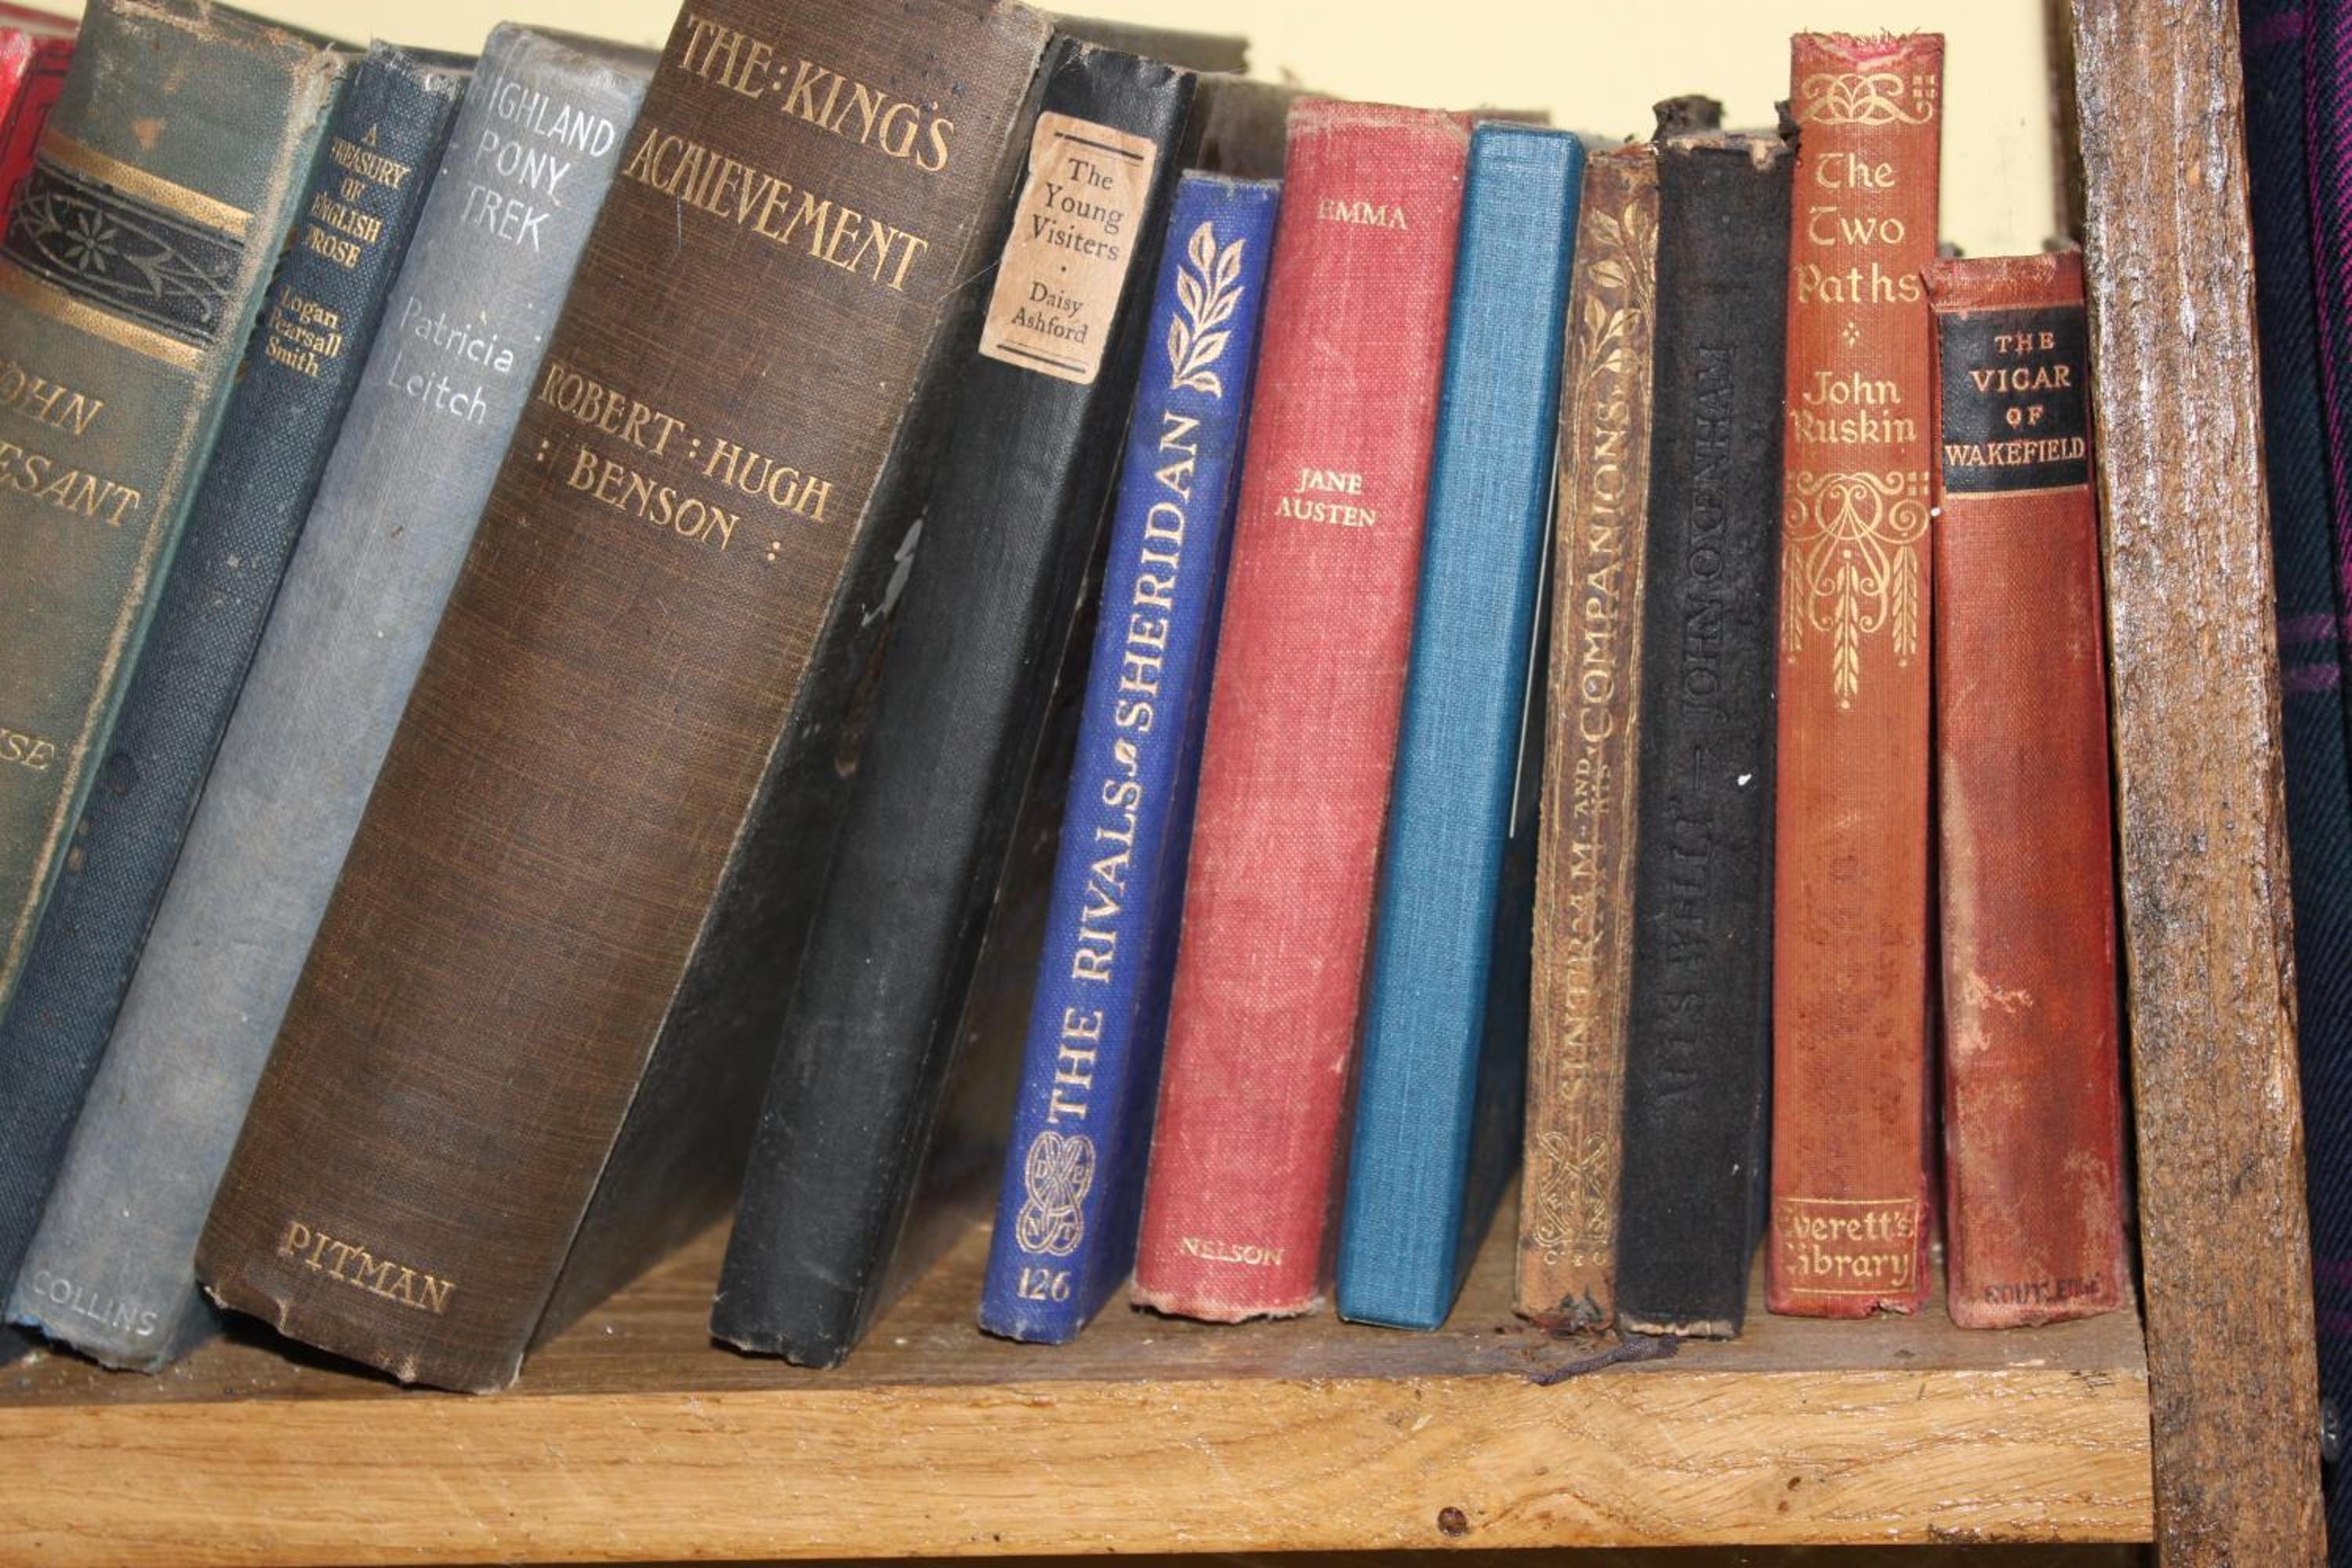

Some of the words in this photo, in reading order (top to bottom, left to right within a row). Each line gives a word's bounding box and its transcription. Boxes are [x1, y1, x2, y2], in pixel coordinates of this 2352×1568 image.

[362, 123, 377, 147] A
[488, 77, 615, 157] IGHLAND
[331, 137, 412, 189] TREASURY
[476, 129, 570, 202] PONY
[1069, 158, 1113, 191] The
[1815, 152, 1896, 189] The
[342, 178, 366, 201] OF
[622, 127, 929, 292] ACHIEVEMENT
[1044, 183, 1123, 234] Young
[312, 192, 383, 243] ENGLISH
[463, 186, 549, 252] TREK
[1316, 198, 1407, 230] EMMA
[1809, 206, 1905, 245] Two
[306, 225, 361, 268] PROSE
[1032, 213, 1120, 261] Visiters
[1029, 281, 1084, 319] Daisy
[1796, 263, 1920, 303] Paths
[281, 285, 339, 329] Logan
[1011, 307, 1089, 346] Ashford
[270, 306, 342, 358] Pearsall
[401, 296, 514, 373] Patricia
[1994, 332, 2055, 354] THE
[266, 336, 318, 376] Smith
[388, 351, 487, 424] Leitch
[1804, 371, 1900, 405] John
[1969, 365, 2071, 392] VICAR
[0, 370, 104, 434] OHN
[2006, 406, 2043, 426] OF
[1790, 408, 1917, 443] Ruskin
[1944, 437, 2085, 467] WAKEFIELD
[0, 440, 140, 527] ESANT
[567, 449, 740, 550] BENSON
[702, 437, 833, 523] HUGH
[1295, 468, 1363, 495] JANE
[1276, 495, 1377, 527] AUSTEN
[1115, 409, 1201, 733] SHERIDAN
[1071, 779, 1142, 985] RIVALS
[1046, 1010, 1104, 1124] THE
[278, 1221, 456, 1315] PITMAN
[1180, 1236, 1283, 1266] NELSON
[33, 1269, 157, 1336] COLLINS
[1018, 1266, 1071, 1302] 126
